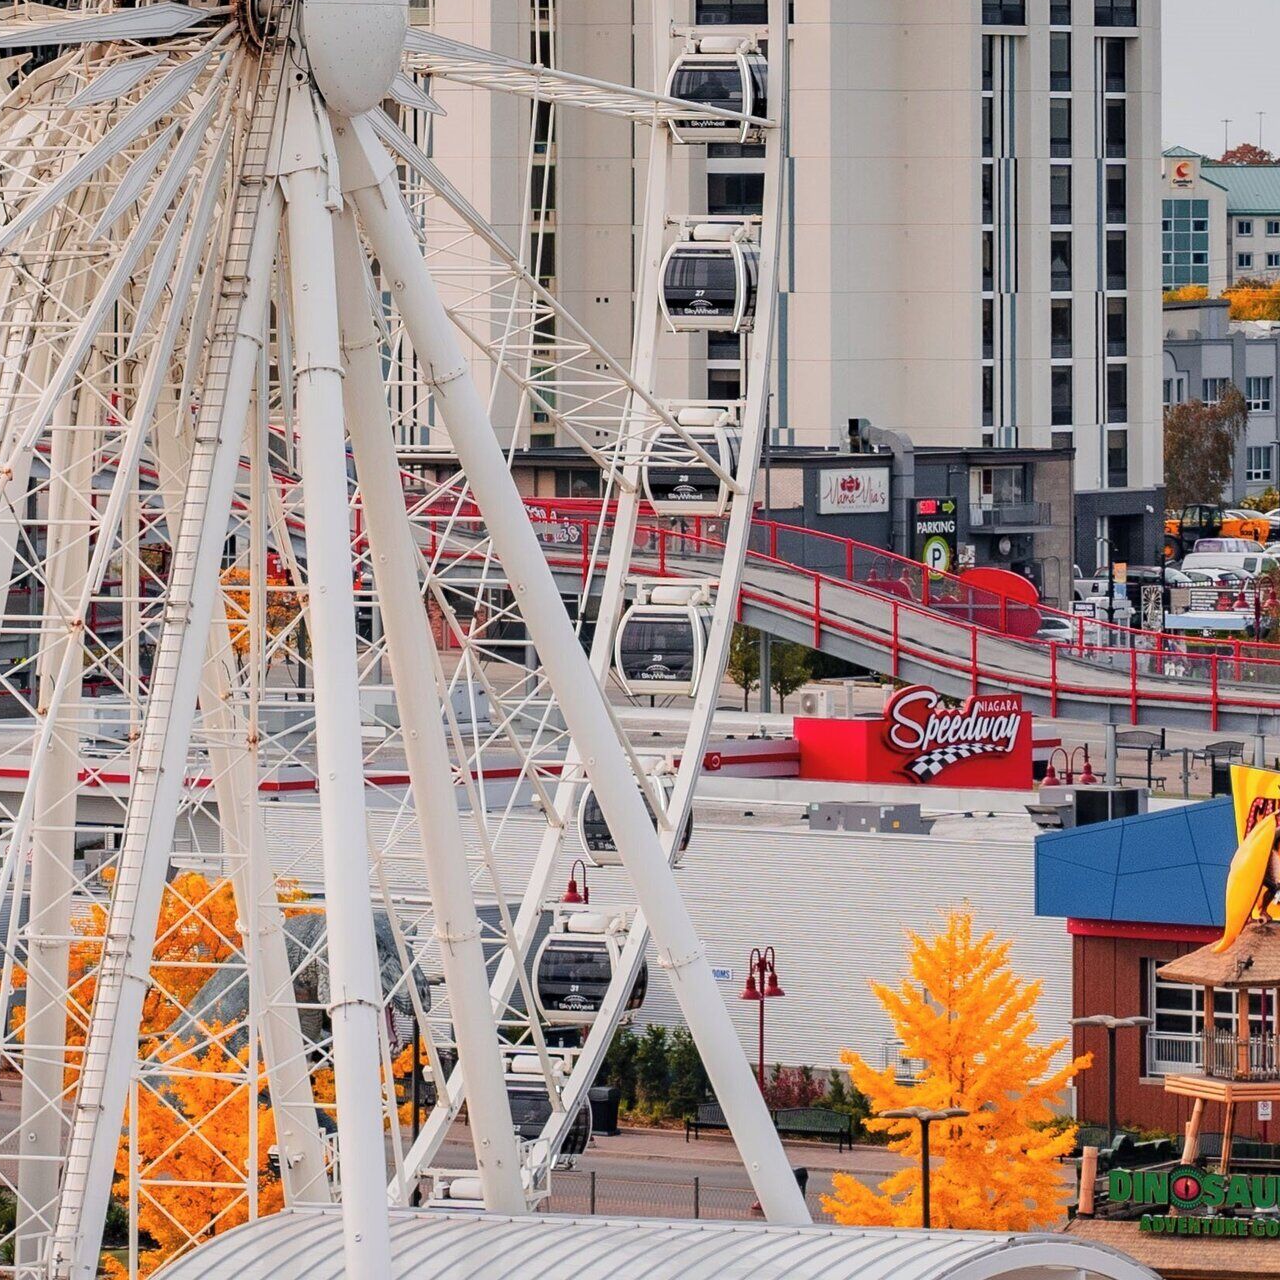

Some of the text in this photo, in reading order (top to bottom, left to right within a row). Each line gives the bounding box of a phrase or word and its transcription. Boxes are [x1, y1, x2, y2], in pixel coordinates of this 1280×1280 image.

[823, 476, 855, 505] Mama
[916, 521, 955, 534] PARKING
[932, 548, 941, 568] P
[978, 700, 1018, 712] NIAGARA
[890, 690, 1021, 752] Speedway
[1139, 1215, 1248, 1236] ADVENTURE
